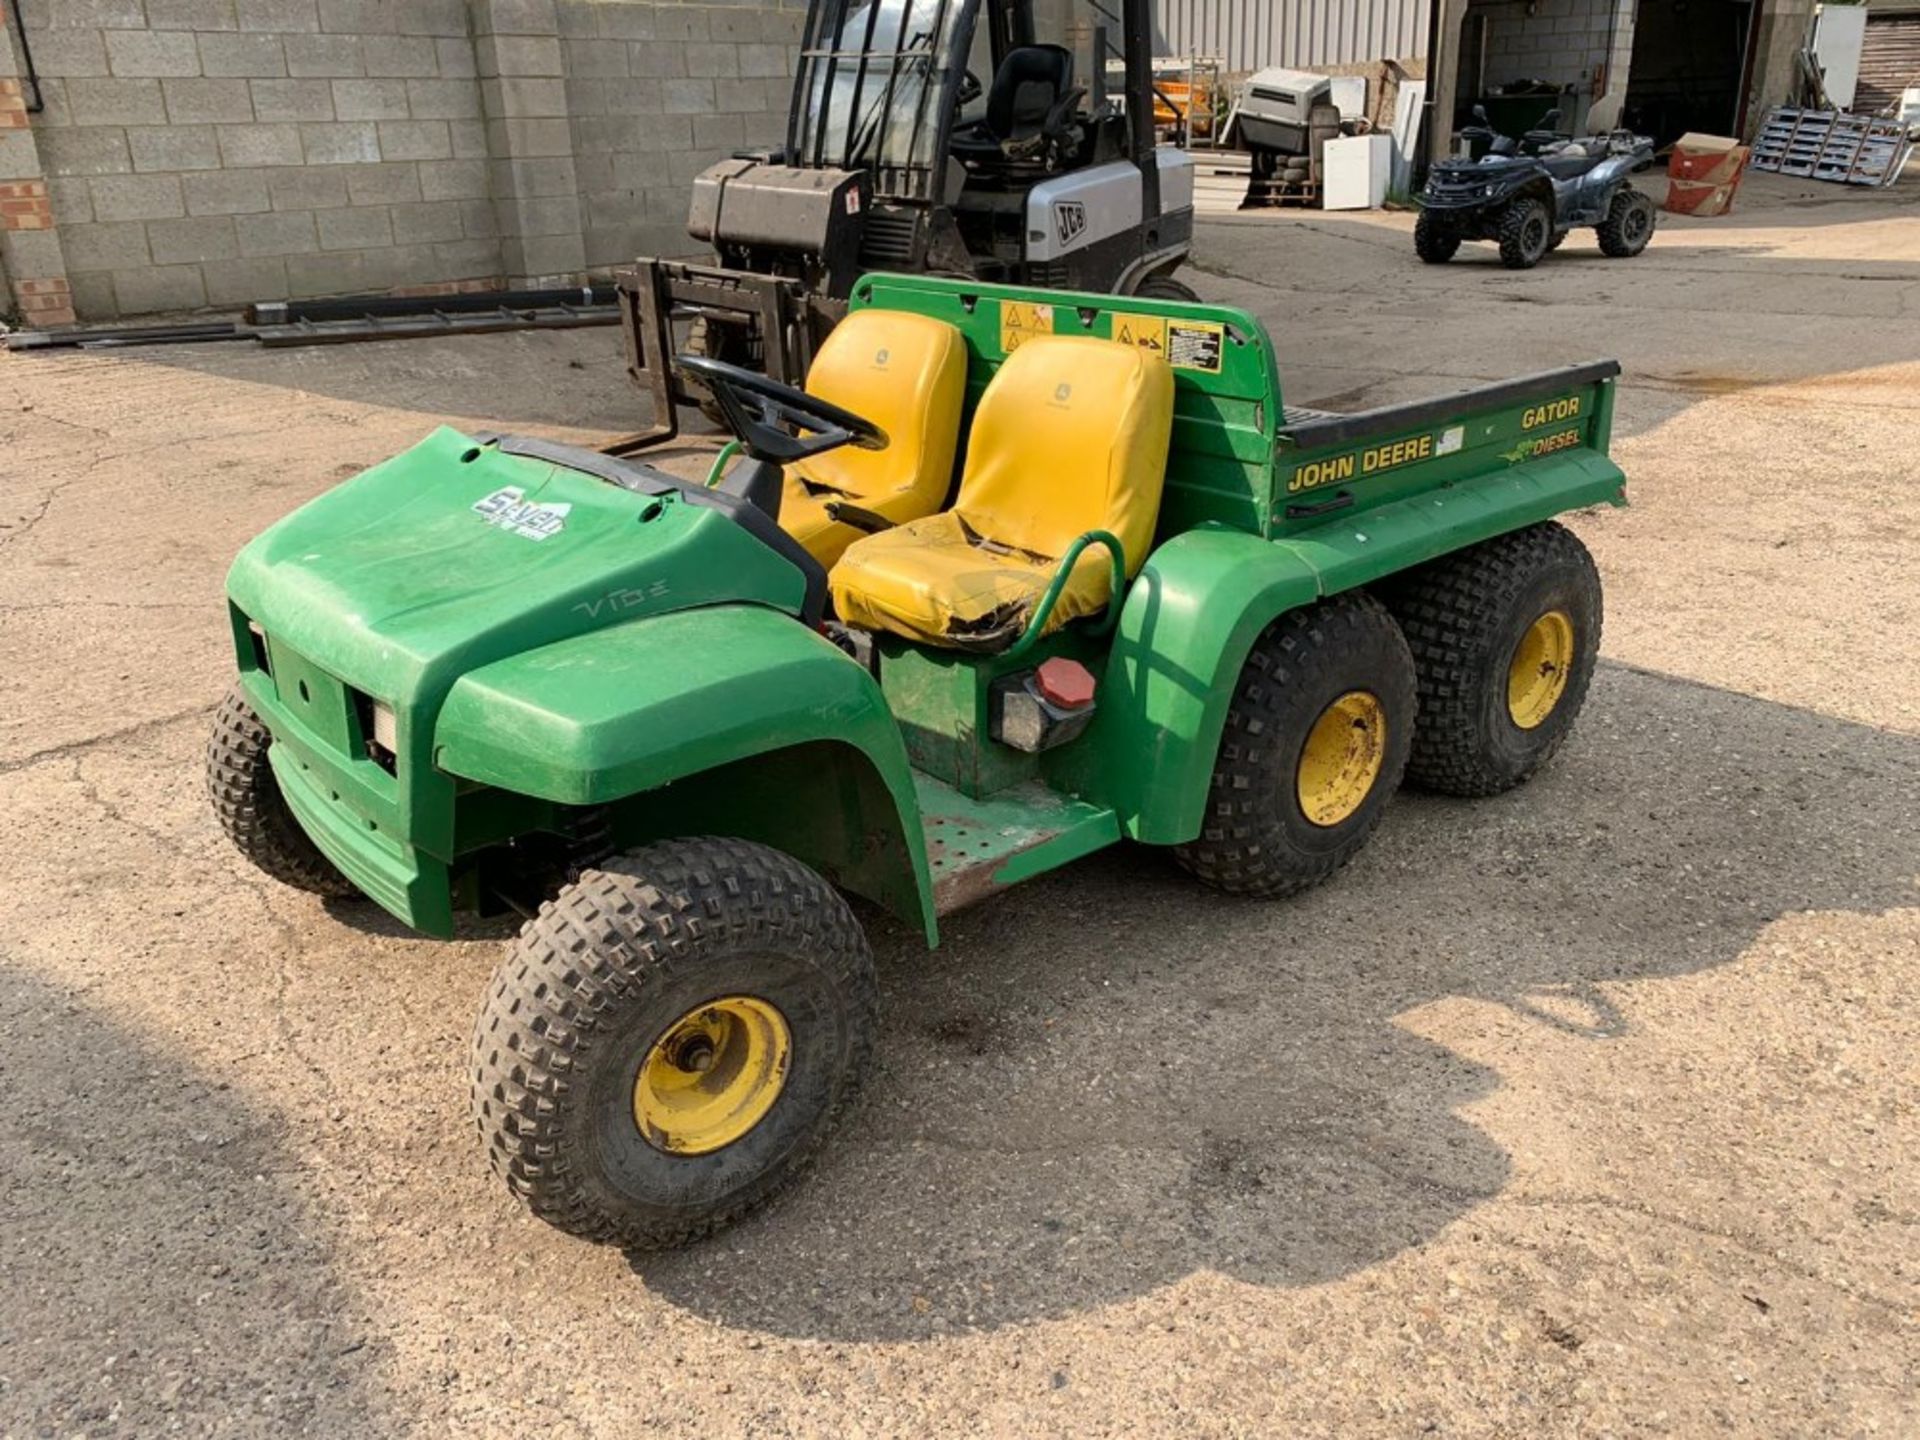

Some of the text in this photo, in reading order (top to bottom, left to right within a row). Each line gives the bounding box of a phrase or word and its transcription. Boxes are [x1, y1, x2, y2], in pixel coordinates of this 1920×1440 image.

[1058, 205, 1084, 241] JCB
[1520, 396, 1582, 430] GATOR
[1533, 428, 1582, 455] DIESEL
[1287, 434, 1432, 493] JOHN DEERE
